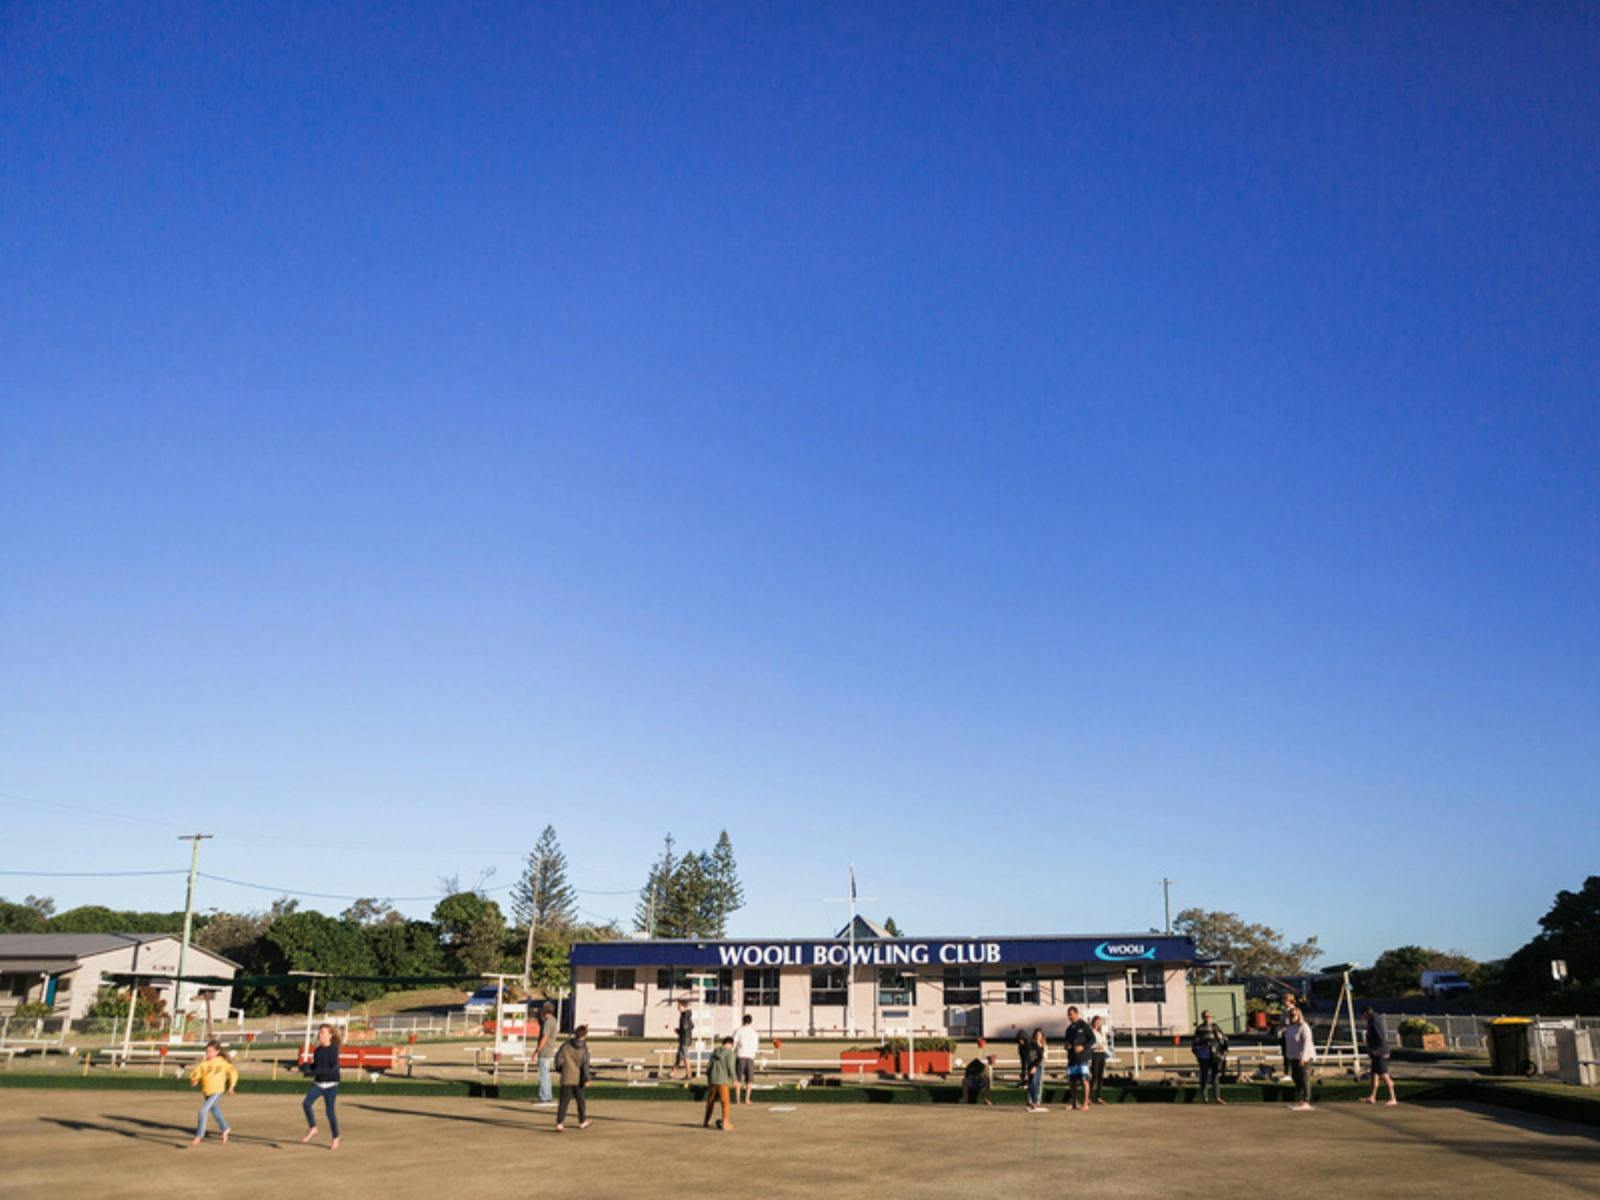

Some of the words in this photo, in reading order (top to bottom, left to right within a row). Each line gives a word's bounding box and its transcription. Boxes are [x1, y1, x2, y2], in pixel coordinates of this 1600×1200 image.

[719, 945, 802, 966] WOOLI
[813, 944, 929, 965] BOWLING
[939, 943, 1001, 964] CLUB
[1107, 944, 1144, 954] WOOLI
